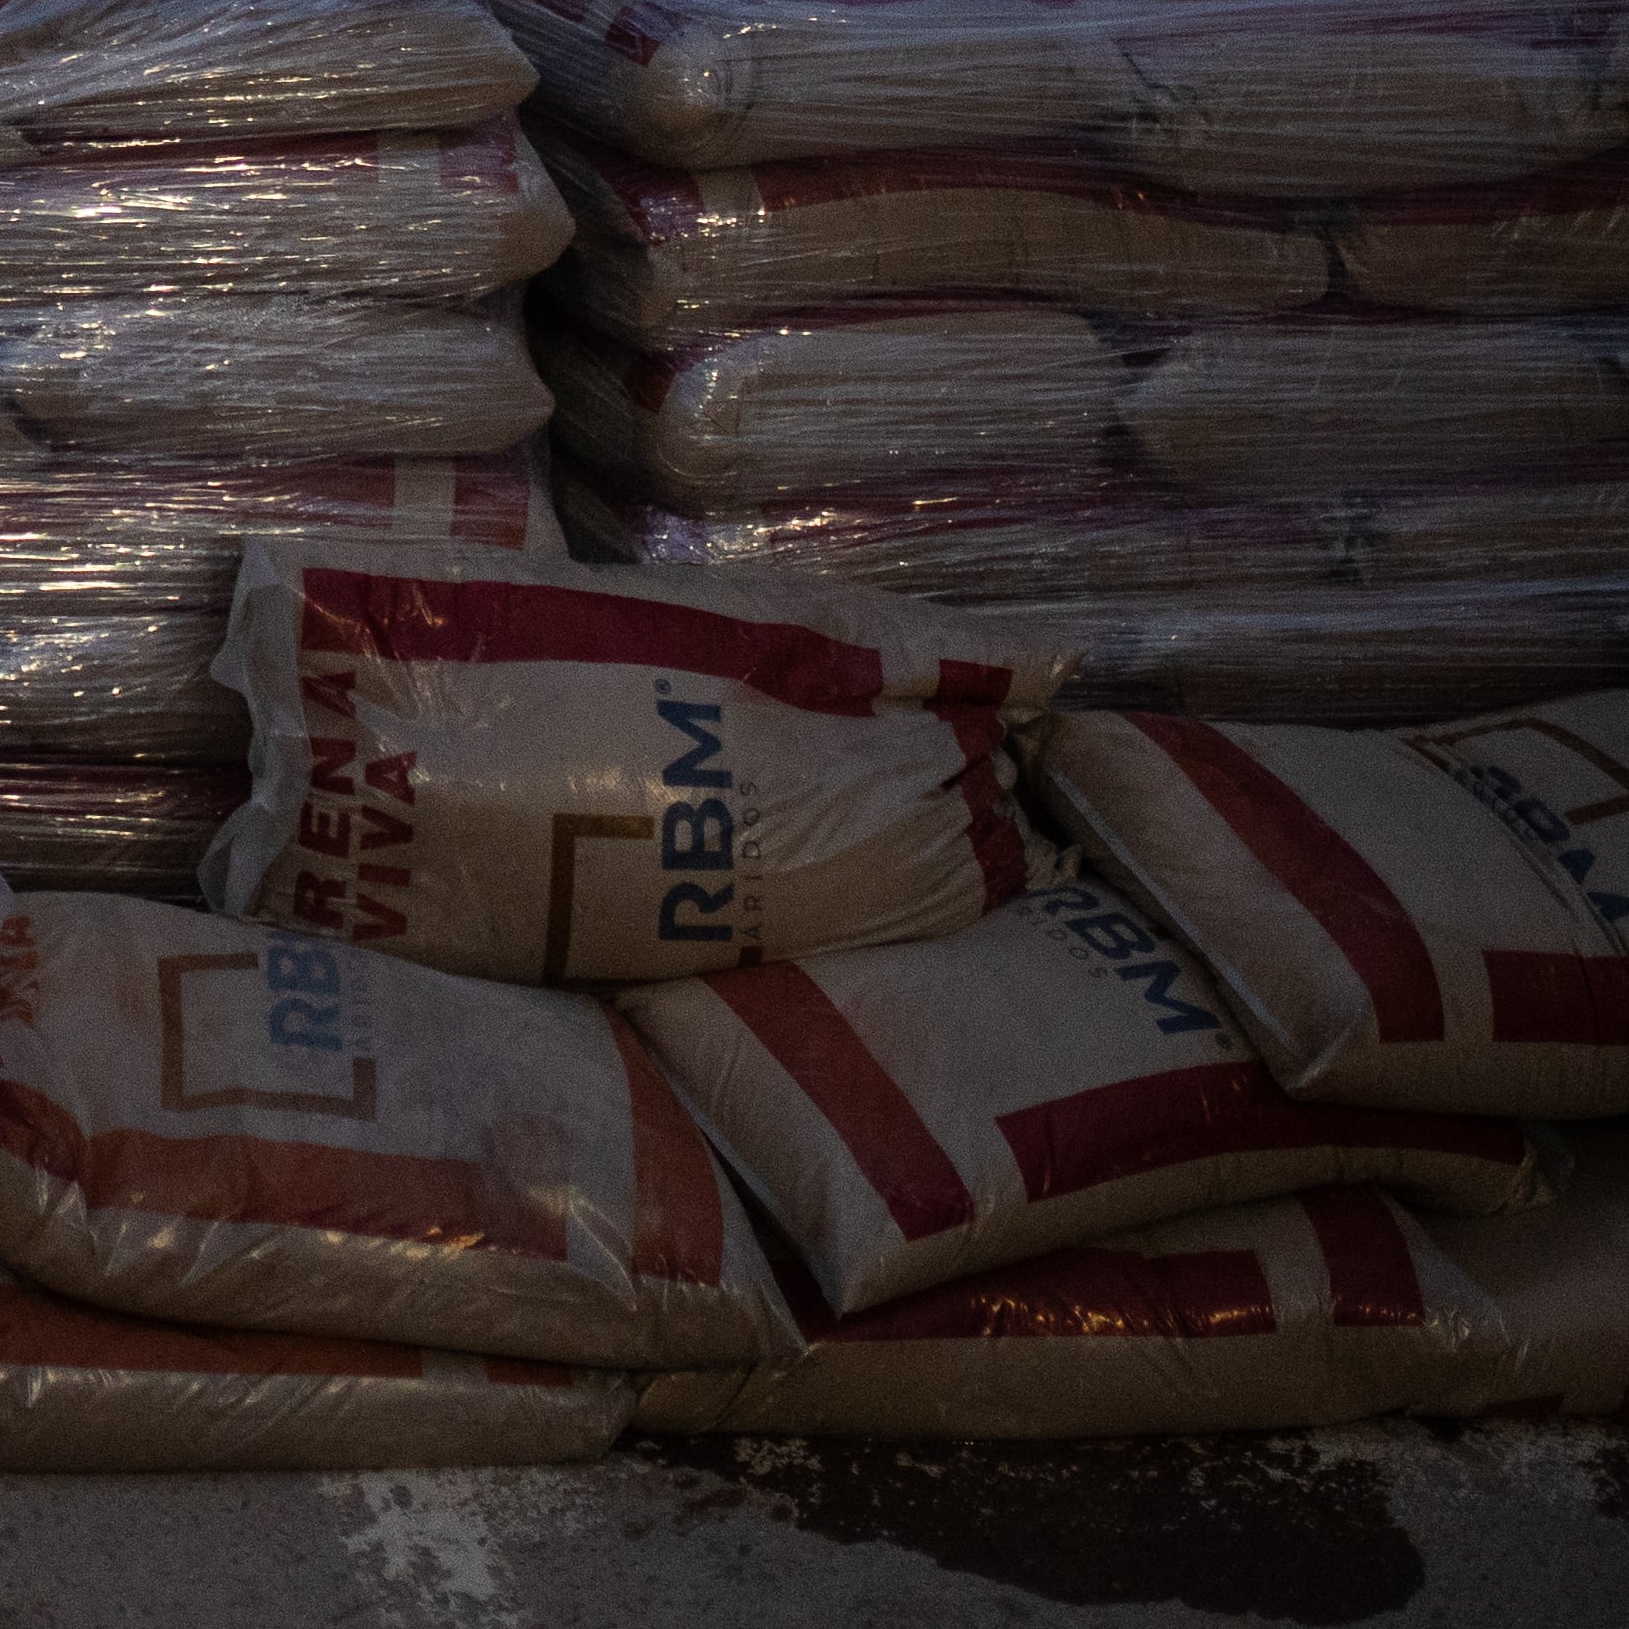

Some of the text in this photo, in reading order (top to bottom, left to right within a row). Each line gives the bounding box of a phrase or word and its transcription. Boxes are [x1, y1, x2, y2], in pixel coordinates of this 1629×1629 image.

[292, 669, 357, 931] RENA
[352, 751, 418, 942] VIVA
[656, 700, 734, 943] RBM
[266, 932, 344, 1053] RB
[1028, 885, 1221, 1036] RBM
